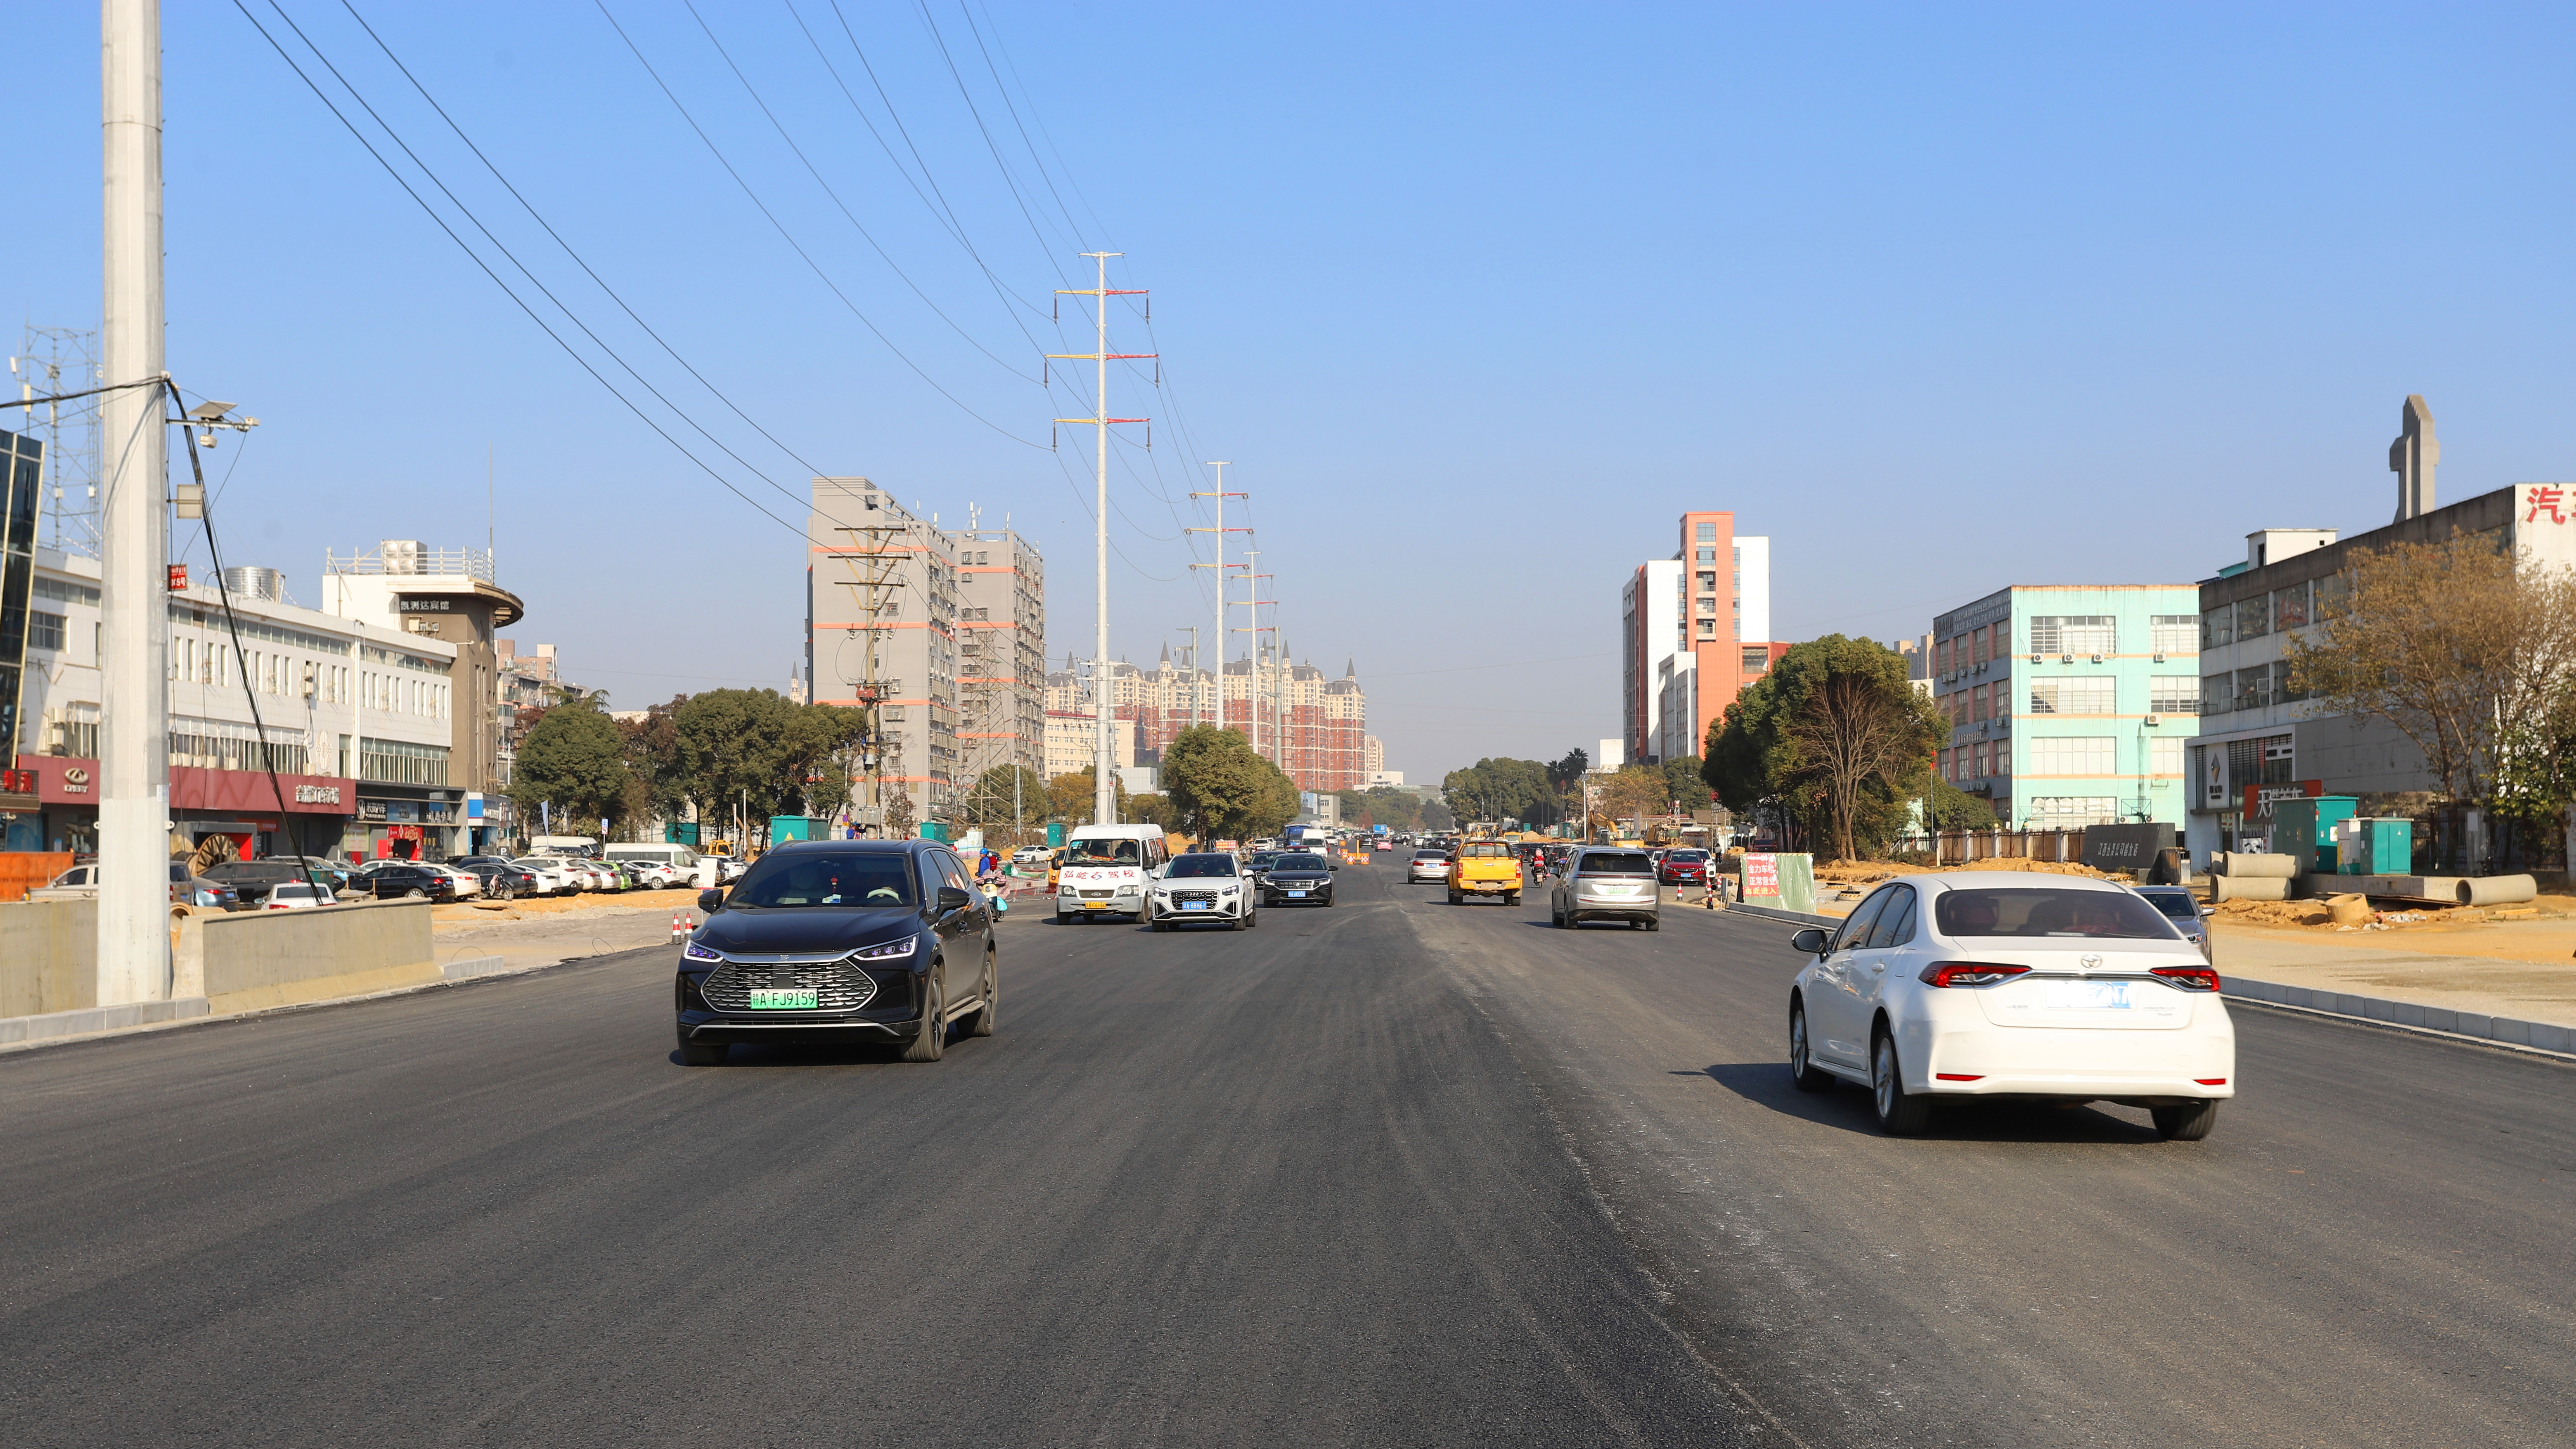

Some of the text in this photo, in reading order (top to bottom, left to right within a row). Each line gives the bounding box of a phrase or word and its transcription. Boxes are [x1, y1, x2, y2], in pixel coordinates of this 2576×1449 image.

[2526, 486, 2576, 525] 汽
[400, 600, 450, 610] 凯利达宾馆
[1748, 864, 1775, 874] 金力车检
[1749, 876, 1776, 885] 正常营业
